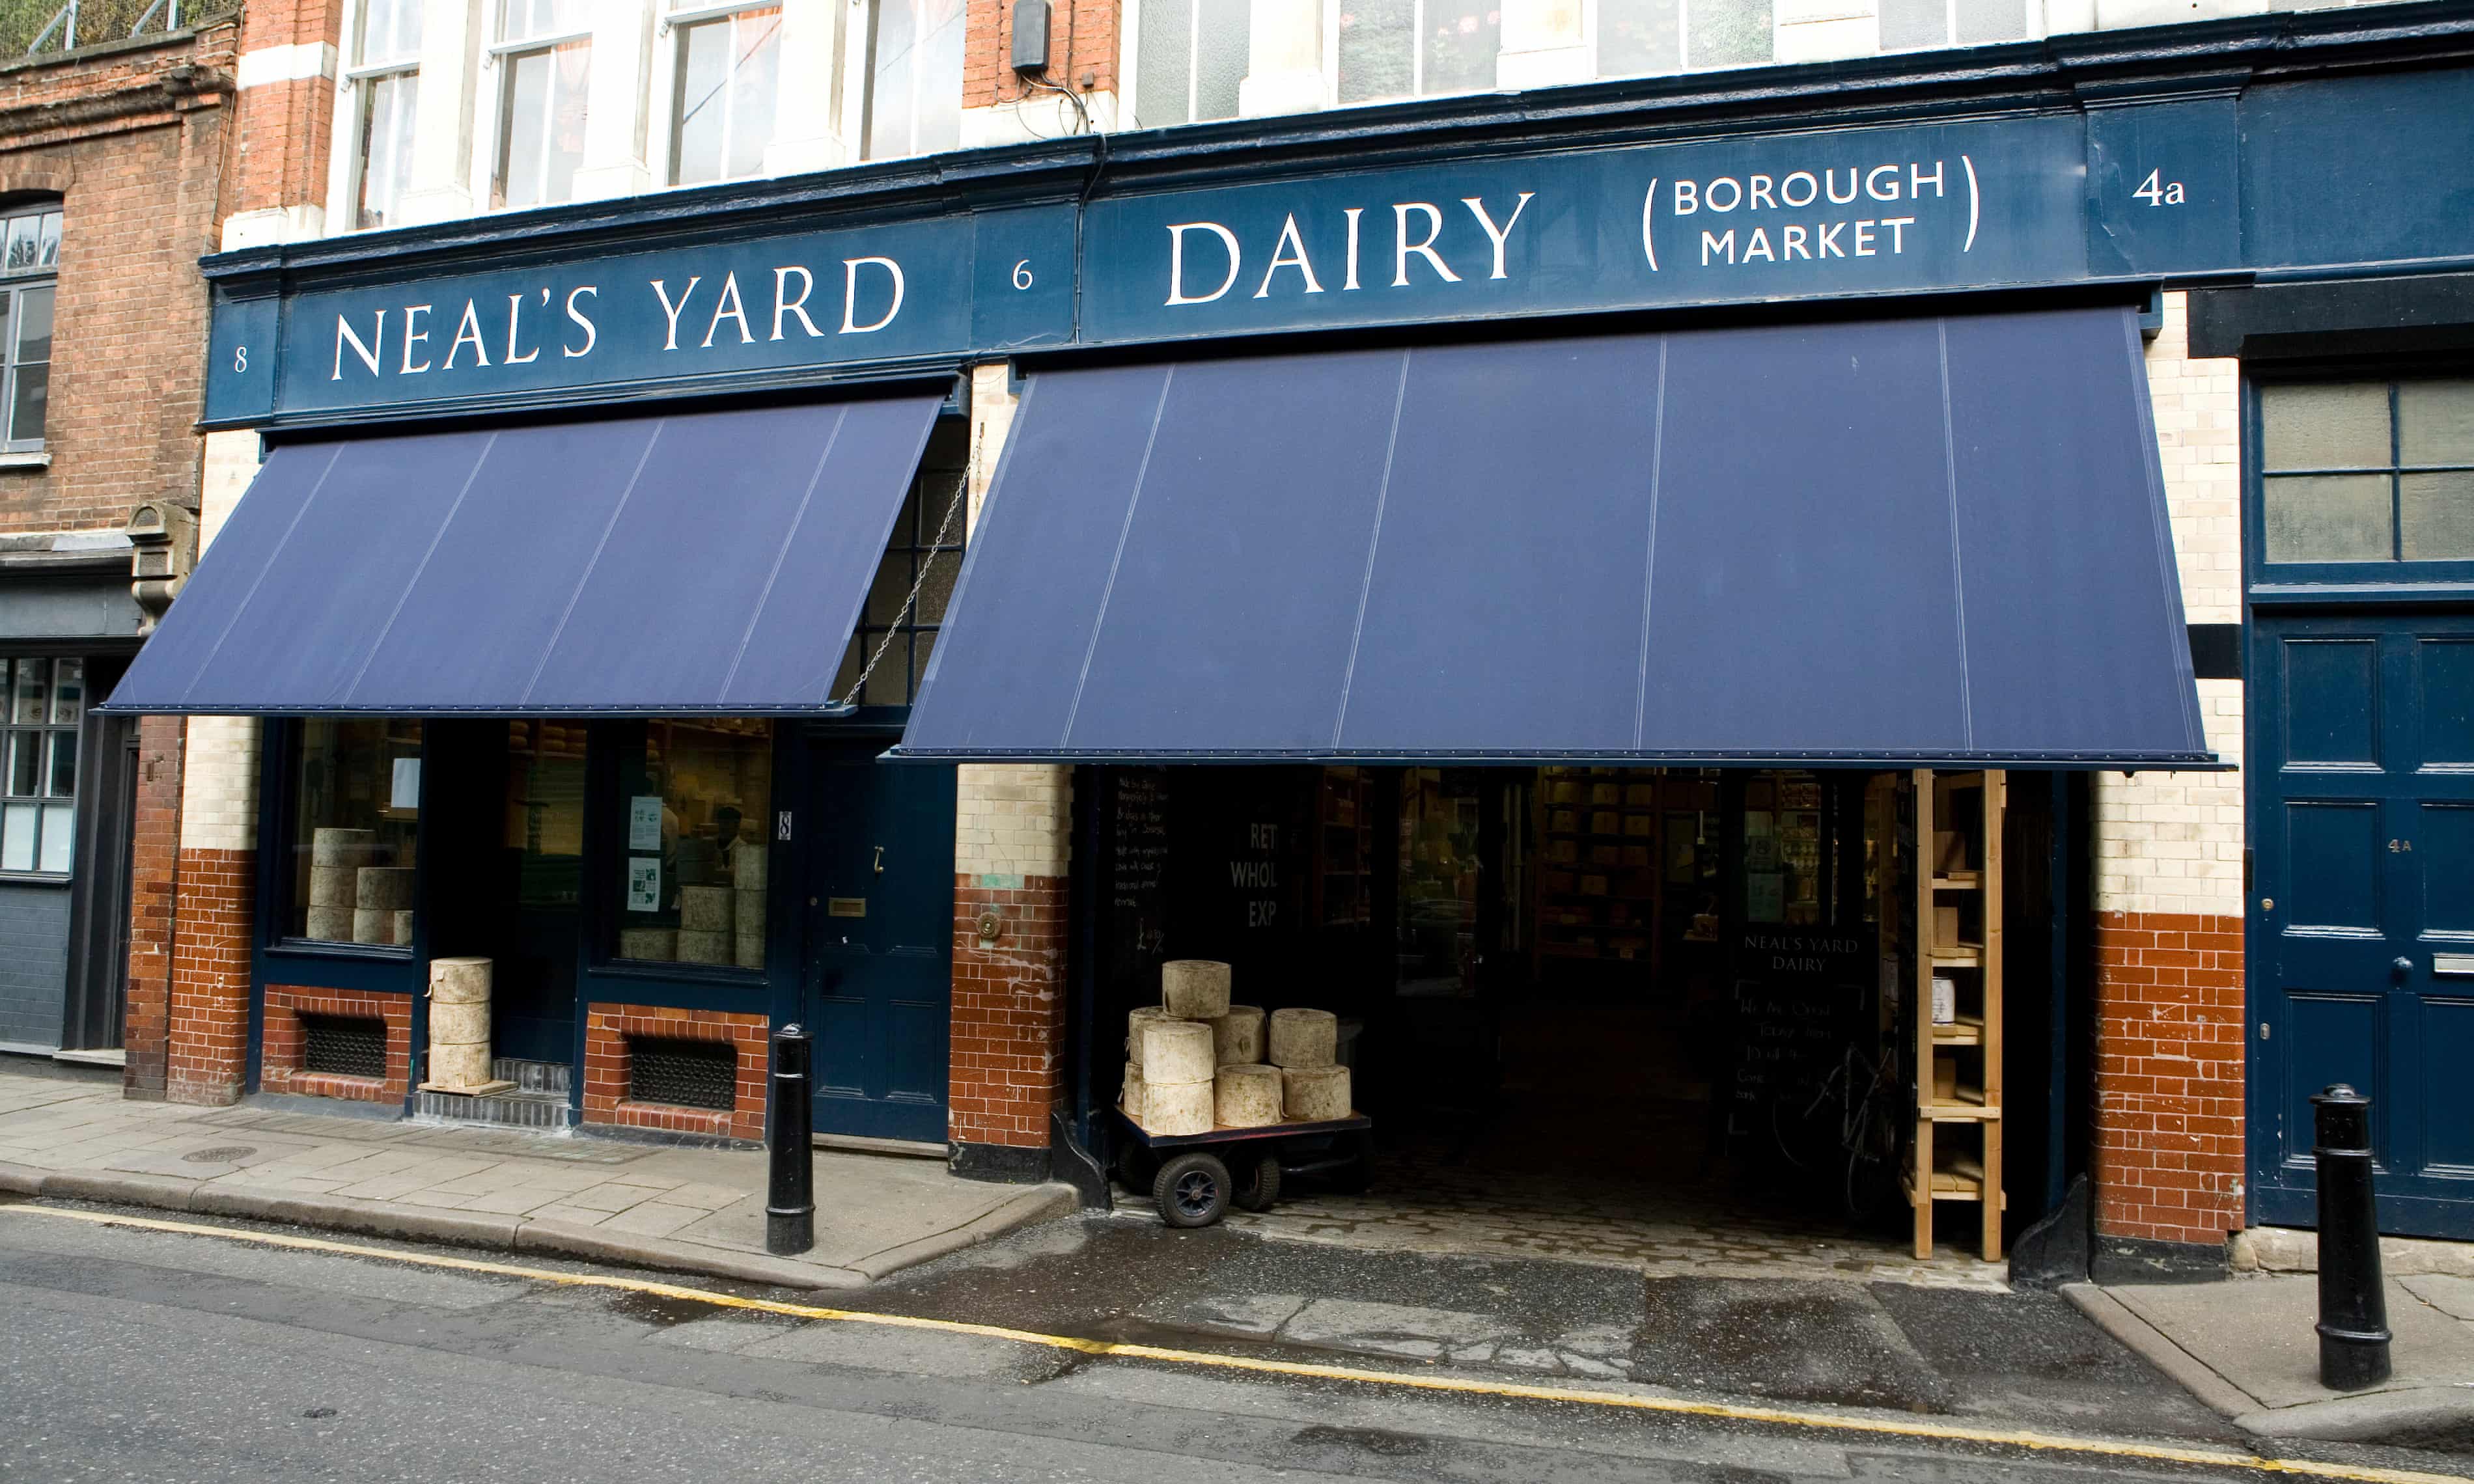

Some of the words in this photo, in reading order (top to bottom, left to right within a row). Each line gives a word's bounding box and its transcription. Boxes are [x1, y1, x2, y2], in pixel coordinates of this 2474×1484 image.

[2132, 168, 2185, 206] 4a
[1164, 192, 1535, 306] DAIRY
[1012, 259, 1033, 291] 6
[331, 286, 597, 381] NEAL'S
[650, 257, 904, 351] YARD
[234, 346, 247, 373] 8
[780, 816, 789, 835] 8
[2388, 839, 2411, 853] 4A
[1249, 901, 1277, 927] EXP
[1745, 935, 1802, 950] NEAL'S
[1809, 938, 1858, 954] YARD
[1773, 956, 1826, 972] DAIRY
